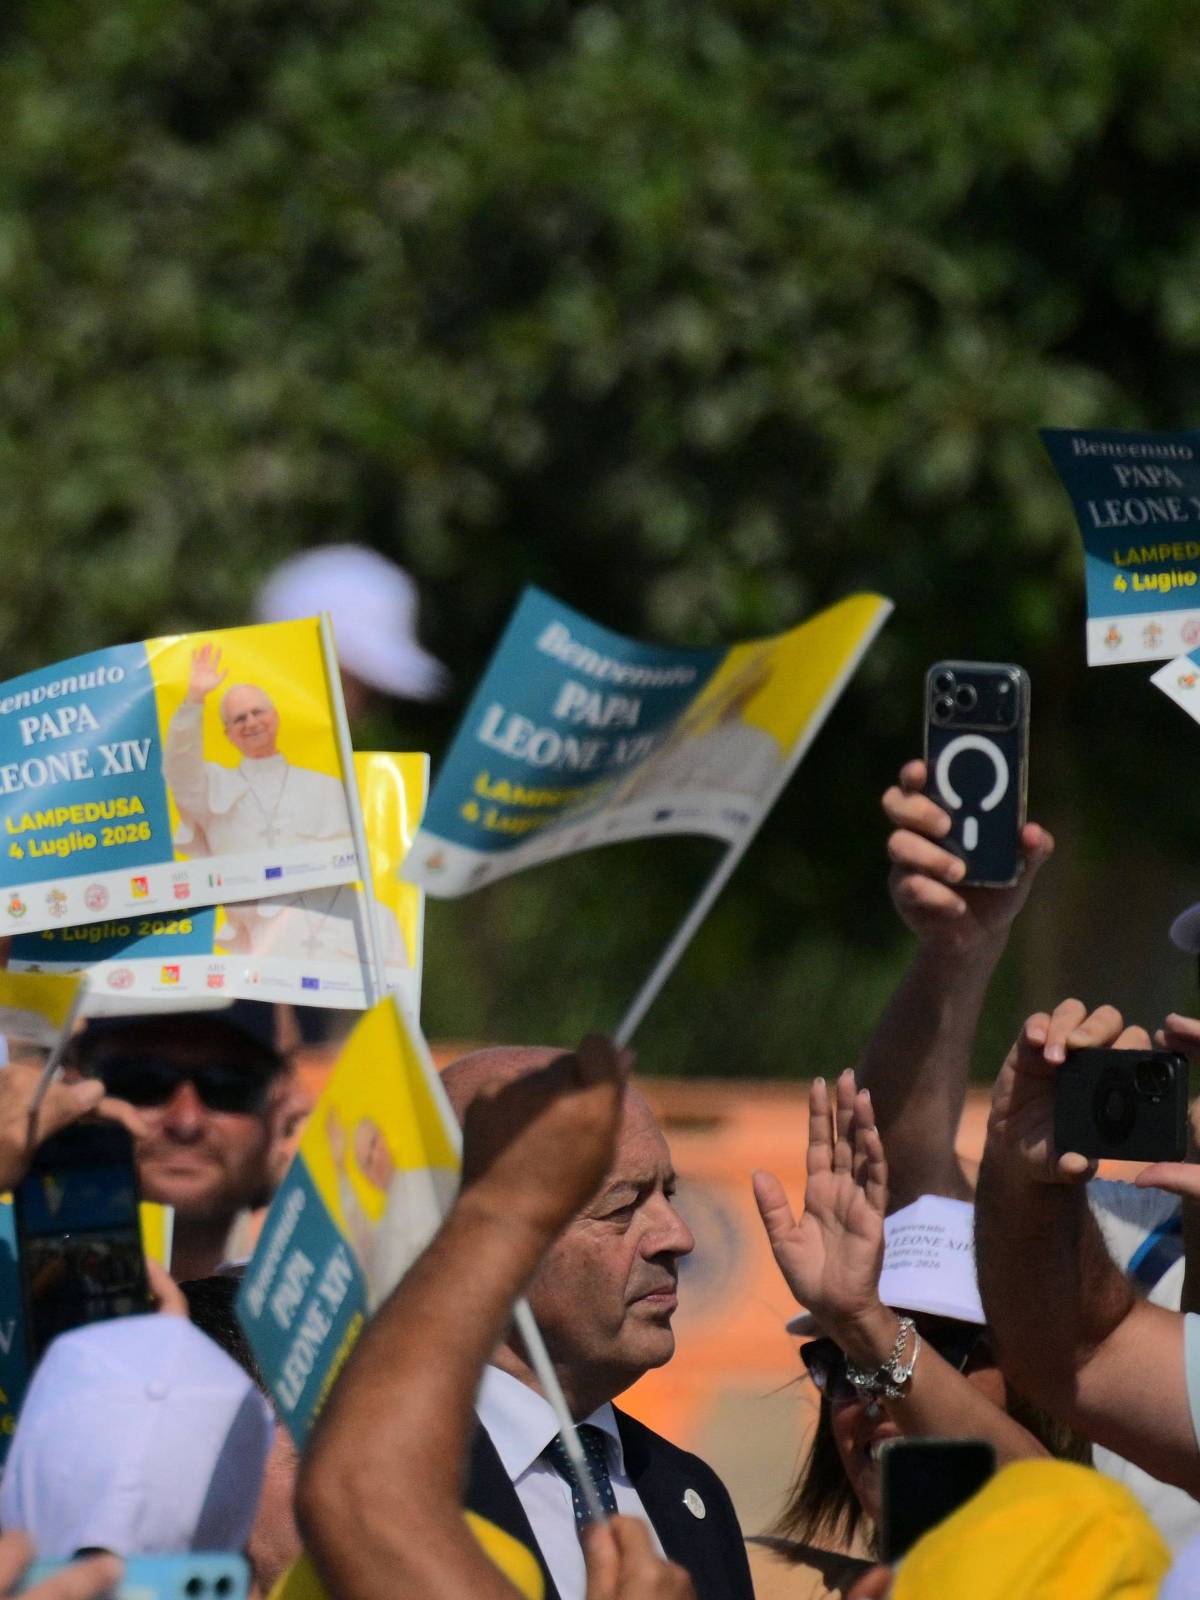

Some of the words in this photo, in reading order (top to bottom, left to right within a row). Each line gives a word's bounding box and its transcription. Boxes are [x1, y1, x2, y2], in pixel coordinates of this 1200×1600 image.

[1071, 437, 1193, 460] Benvenuto
[1113, 464, 1184, 488] PAPA
[1088, 496, 1189, 528] LEONE
[1114, 541, 1200, 566] LAMPED
[1113, 574, 1128, 593] 4
[1132, 569, 1197, 593] Luglio
[19, 702, 100, 746] PAPA
[98, 738, 152, 777] XIV
[5, 795, 145, 834] LAMPEDUSA
[8, 842, 24, 860] 4
[27, 830, 98, 858] Luglio
[101, 821, 152, 847] 2026
[42, 929, 54, 941] 4
[63, 921, 130, 942] Luglio
[138, 919, 193, 936] 2026
[892, 1236, 945, 1248] LEONE
[277, 1296, 333, 1412] LEONE
